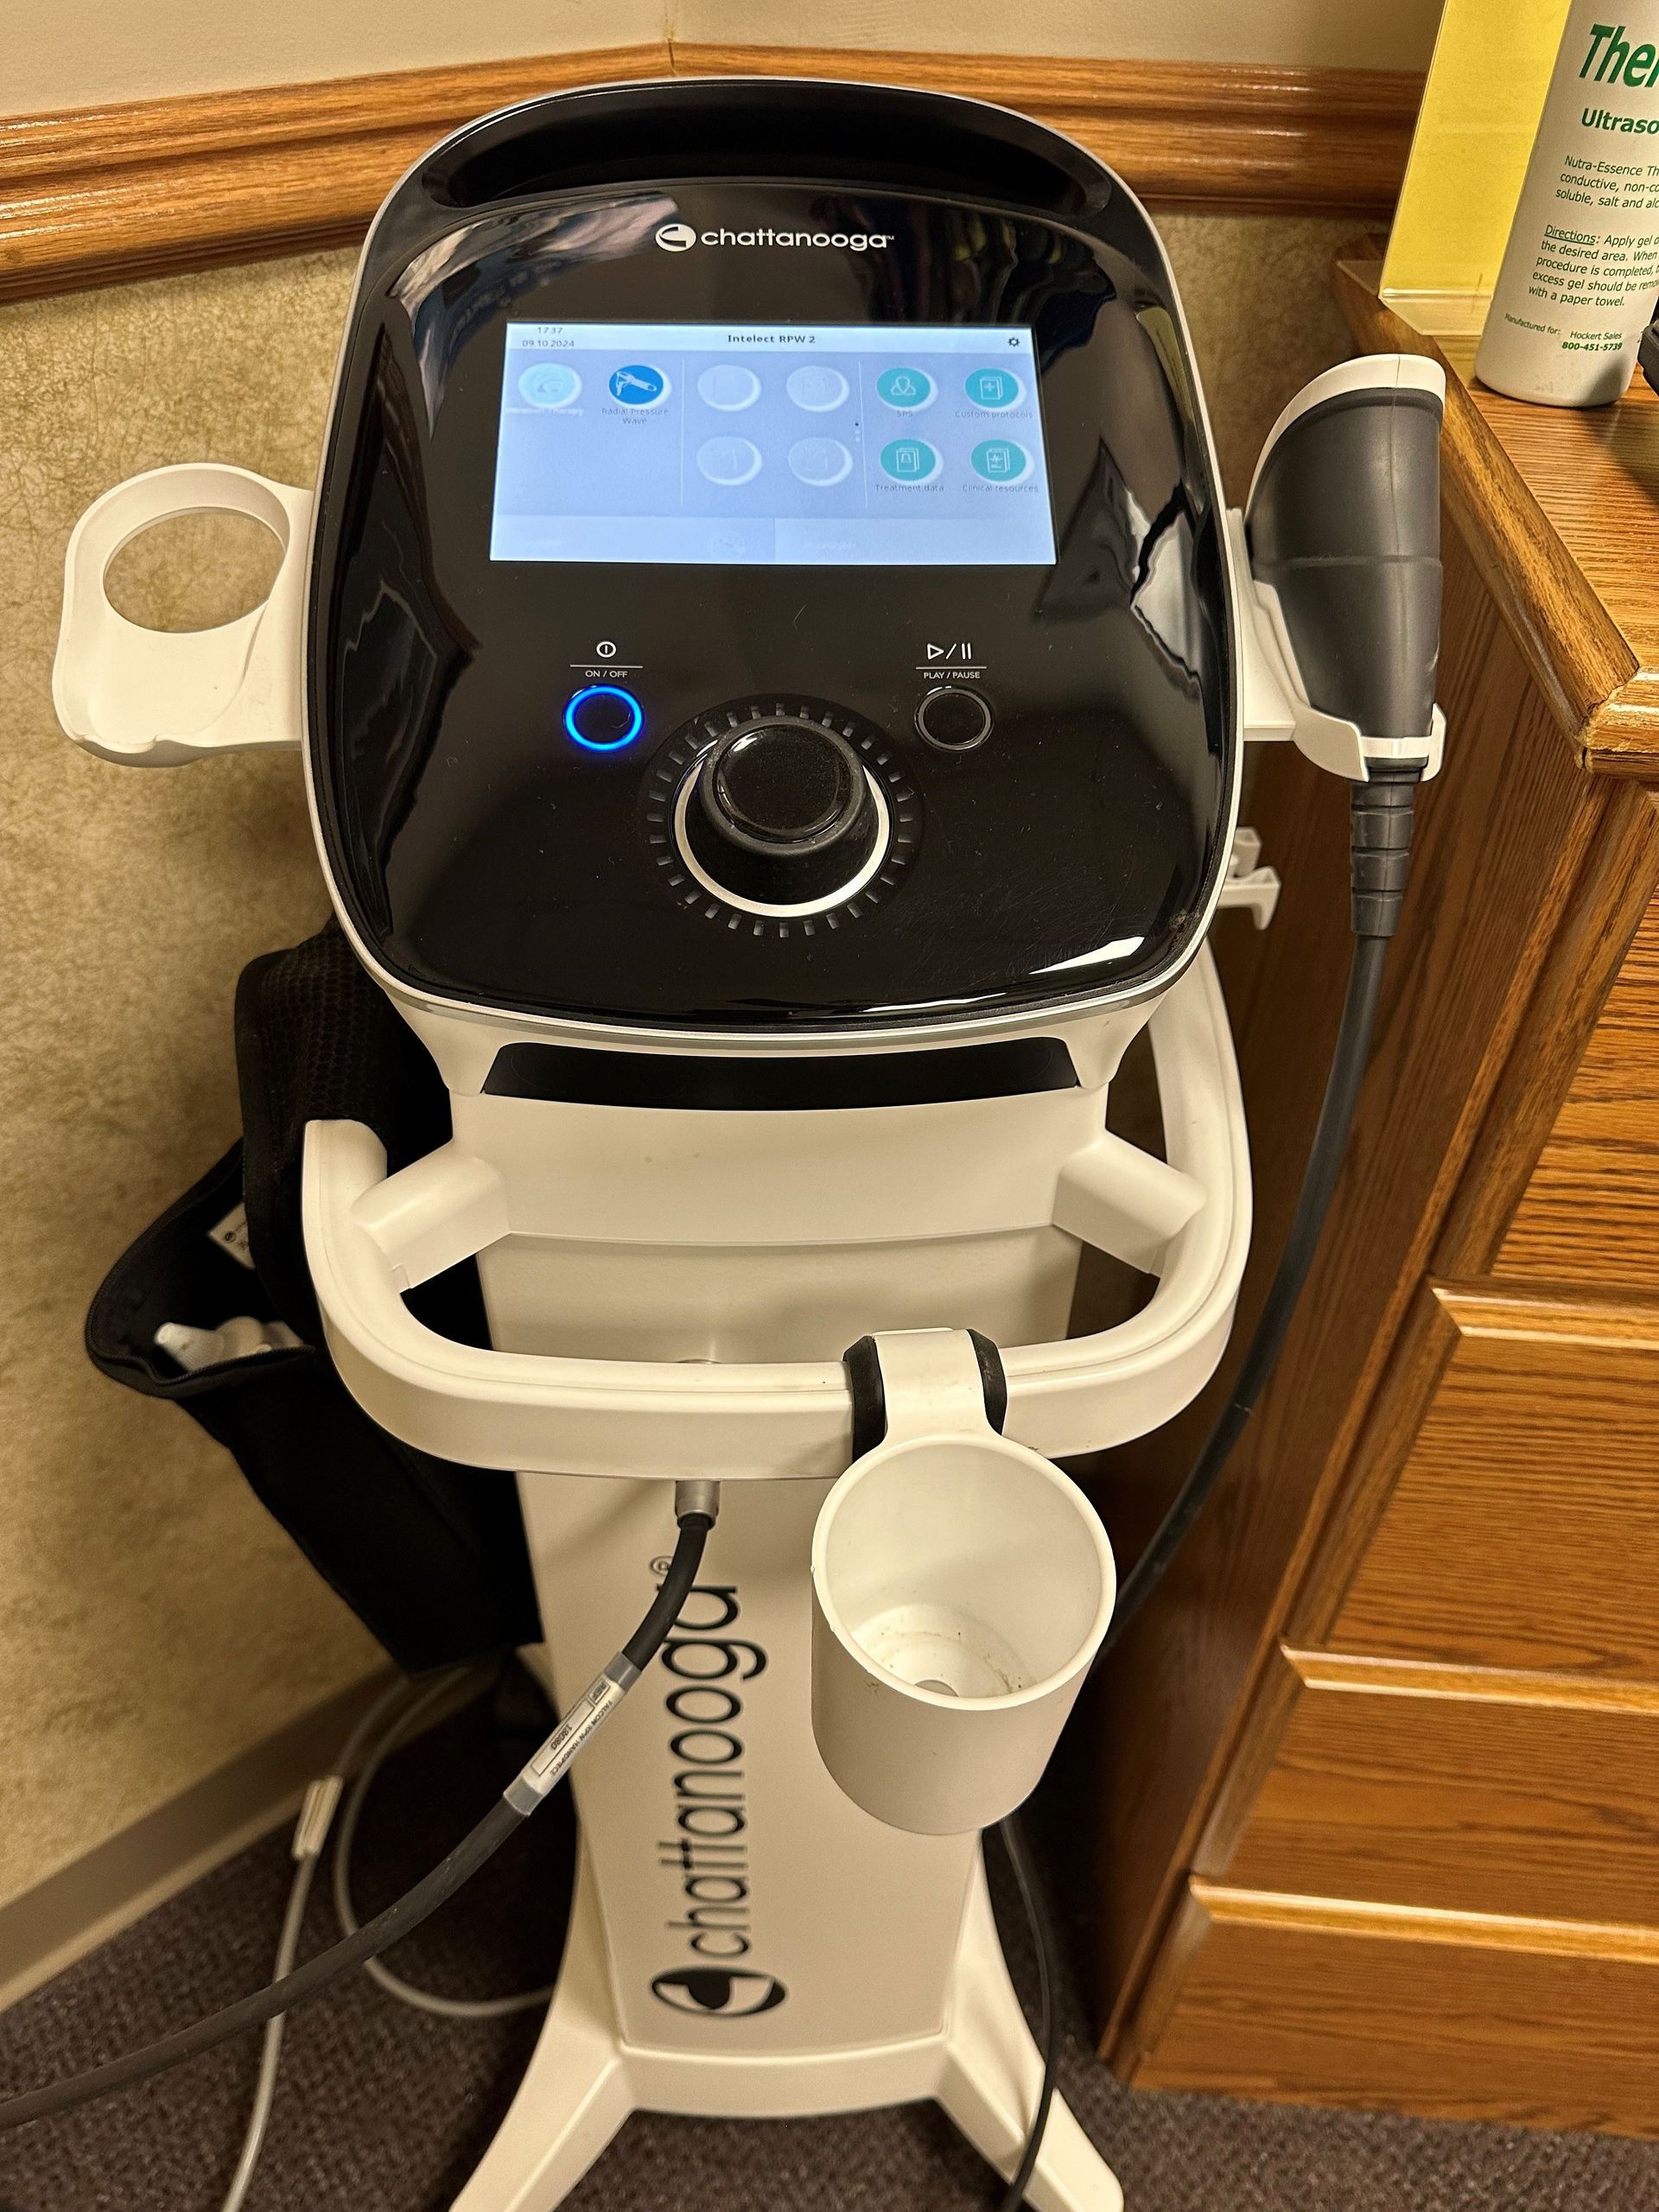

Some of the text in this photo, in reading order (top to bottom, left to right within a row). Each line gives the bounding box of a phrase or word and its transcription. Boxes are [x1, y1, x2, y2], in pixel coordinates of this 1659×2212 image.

[1581, 108, 1659, 135] Ultraso
[1564, 155, 1643, 176] Nutra-Essence
[1560, 172, 1619, 194] conductive,
[1555, 188, 1593, 206] soluble,
[1598, 194, 1618, 207] salt
[1622, 198, 1643, 208] and
[1544, 224, 1600, 245] Directions:
[1604, 235, 1635, 248] Apply
[1637, 235, 1653, 248] gel
[1541, 240, 1657, 261] the desired area. When
[1536, 256, 1587, 274] procedure
[1591, 265, 1600, 275] is
[1604, 265, 1653, 279] completed,
[1532, 270, 1565, 286] excess
[1567, 280, 1585, 290] gel
[1587, 281, 1624, 291] should
[1625, 281, 1637, 291] be
[1529, 285, 1548, 298] with
[1560, 294, 1593, 306] paper
[1595, 296, 1625, 306] towel.
[1504, 312, 1560, 335] Manufactured for:
[728, 334, 816, 344] Intelect RPW 2
[1570, 331, 1622, 340] Hockert Sales
[1561, 341, 1623, 351] 800-451-5739
[955, 410, 1033, 421] Custom protocols
[875, 484, 944, 493] Treatment data
[963, 484, 1038, 493] Clinical resources
[585, 670, 601, 678] ON
[609, 670, 628, 678] OFF
[923, 671, 944, 680] PLAY
[952, 671, 981, 680] PAUSE
